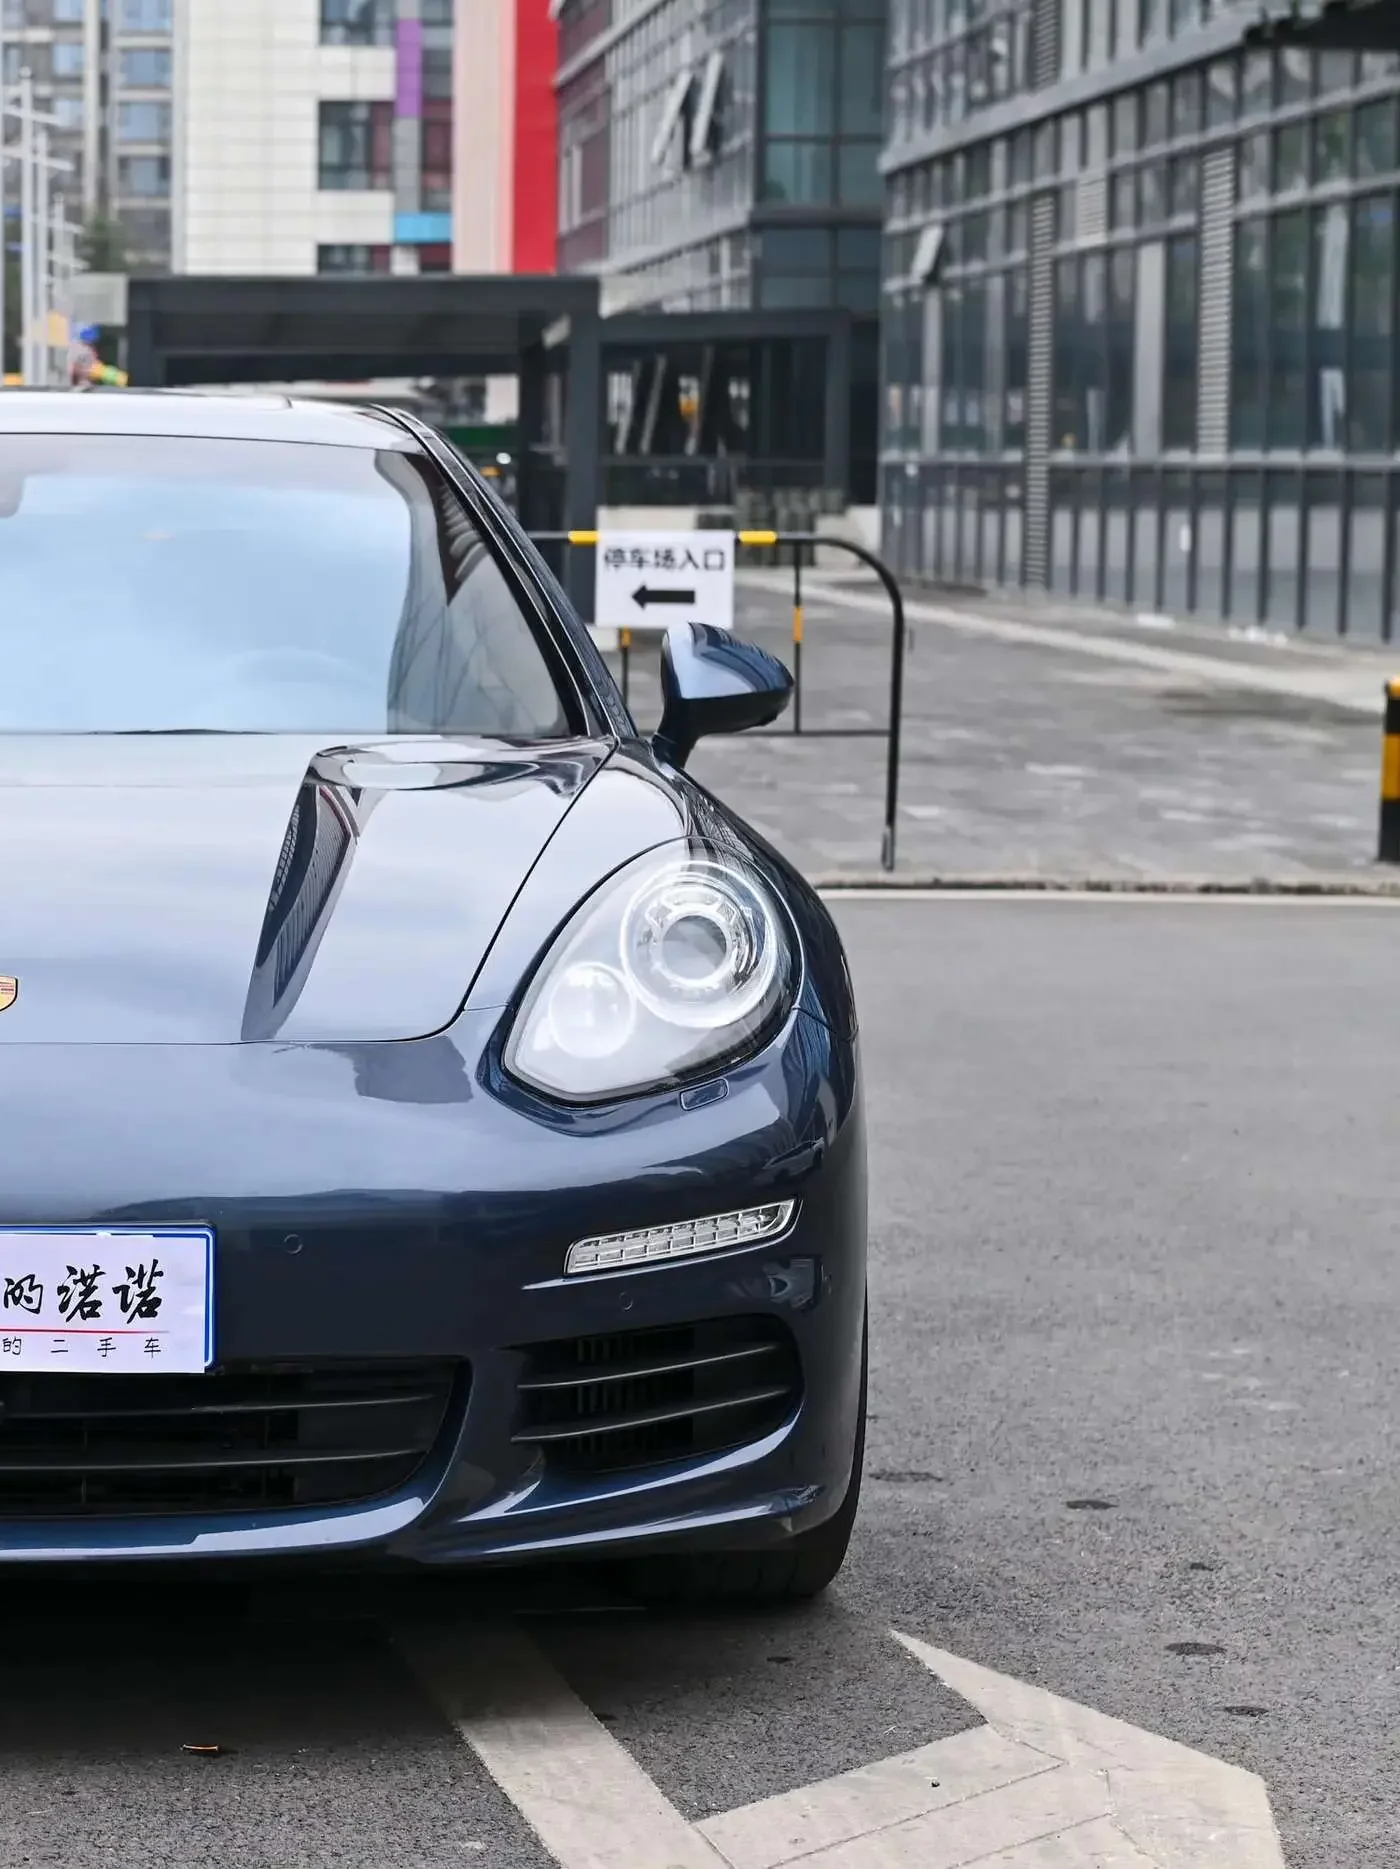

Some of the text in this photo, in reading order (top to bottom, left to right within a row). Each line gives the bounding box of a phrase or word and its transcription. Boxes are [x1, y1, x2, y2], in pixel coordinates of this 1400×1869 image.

[604, 547, 725, 571] 停车场入口
